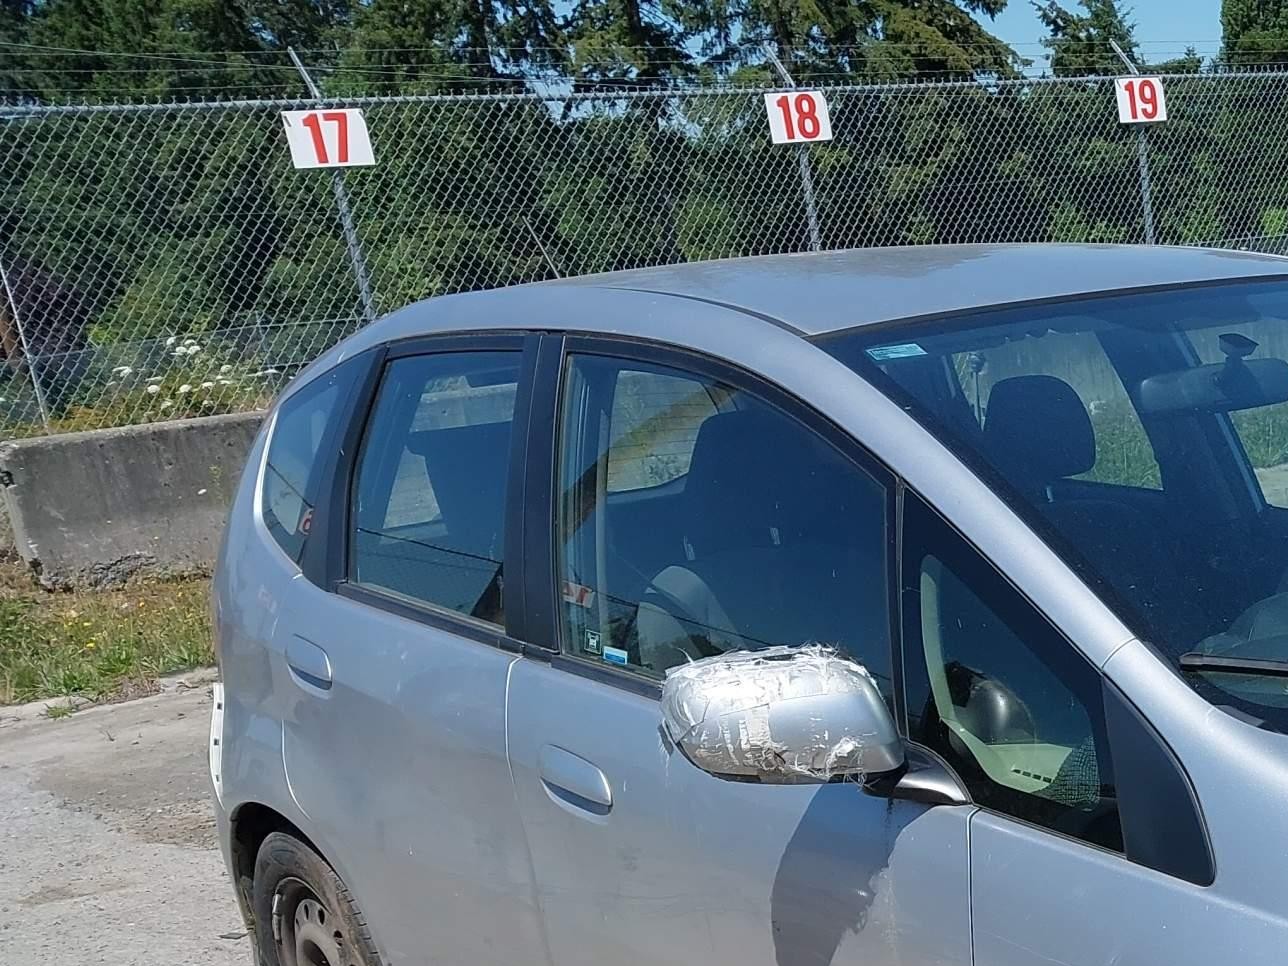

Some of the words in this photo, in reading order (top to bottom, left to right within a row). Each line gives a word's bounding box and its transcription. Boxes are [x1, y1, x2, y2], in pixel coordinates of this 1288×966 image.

[776, 94, 820, 140] 18
[1124, 79, 1158, 119] 19
[302, 112, 349, 164] 17
